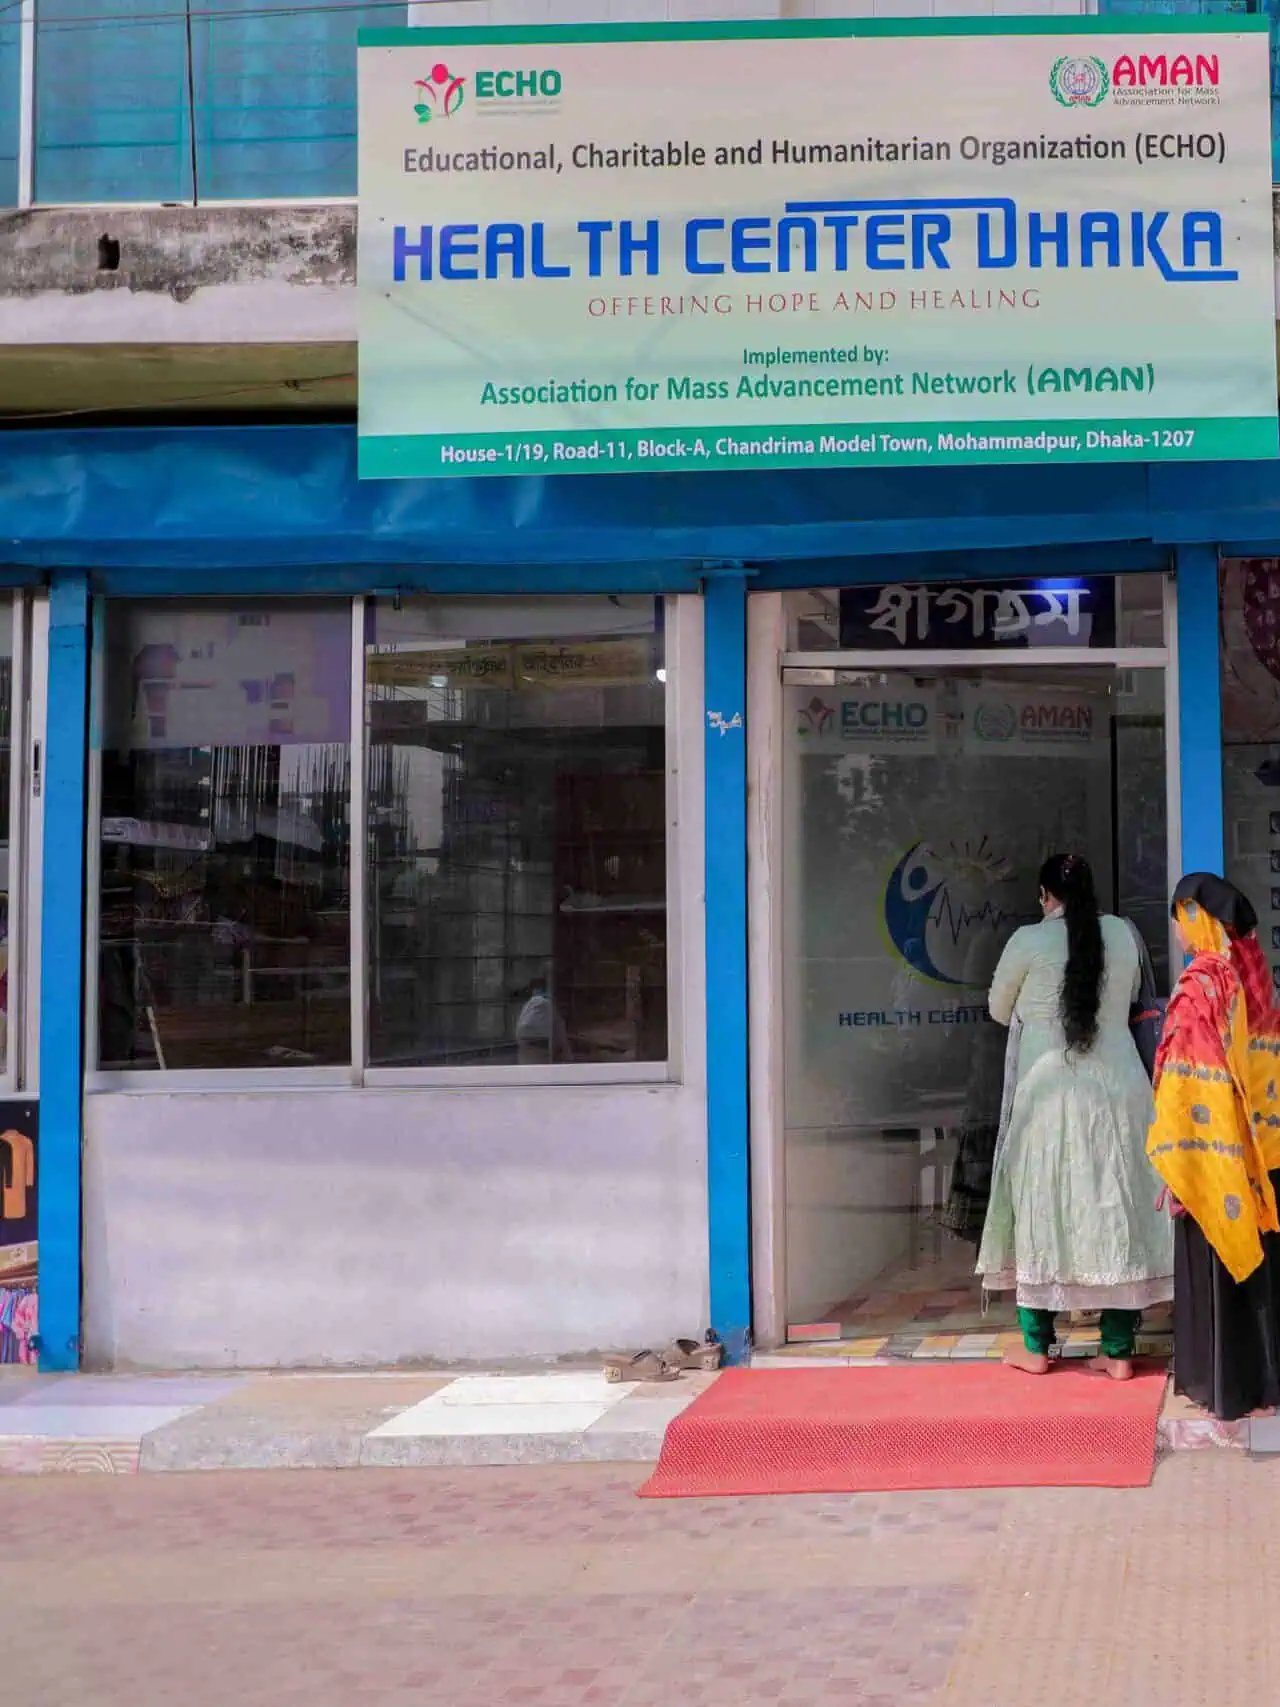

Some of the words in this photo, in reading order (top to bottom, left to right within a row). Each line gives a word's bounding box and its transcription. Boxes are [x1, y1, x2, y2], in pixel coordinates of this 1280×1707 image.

[475, 69, 562, 97] ECHO
[1112, 54, 1219, 86] AMAN
[403, 144, 562, 174] Educational,
[572, 141, 706, 169] Charitable
[714, 140, 762, 166] and
[771, 136, 951, 164] Humanitarian
[960, 134, 1126, 164] Organization
[1135, 132, 1226, 164] (ECHO)
[392, 219, 660, 282] HEALTH
[684, 212, 952, 275] CENTER
[976, 198, 1239, 282] DHAKA
[588, 294, 733, 317] OFFERING
[746, 292, 819, 314] HOPE
[832, 290, 896, 312] AND
[910, 288, 1041, 311] HEALING
[743, 346, 858, 368] Implemented
[862, 345, 889, 367] by:
[480, 379, 618, 406] Association
[625, 376, 660, 402] for
[667, 376, 729, 401] Mass
[736, 372, 904, 399] Advancement
[912, 369, 1017, 395] Network
[1027, 363, 1155, 396] (AMAN)
[440, 444, 549, 466] House-1/19,
[553, 441, 634, 463] Road-11,
[637, 438, 712, 459] Block-A,
[715, 436, 815, 457] Chandrima
[818, 434, 876, 455] Model
[879, 434, 933, 455] Town,
[937, 431, 1083, 454] Mohammadpur,
[1086, 429, 1196, 450] Dhaka-1207
[864, 584, 1091, 645] স্বাগতম
[841, 700, 928, 729] ECHO
[1019, 704, 1093, 729] AMAN
[839, 1009, 921, 1028] HEALTH
